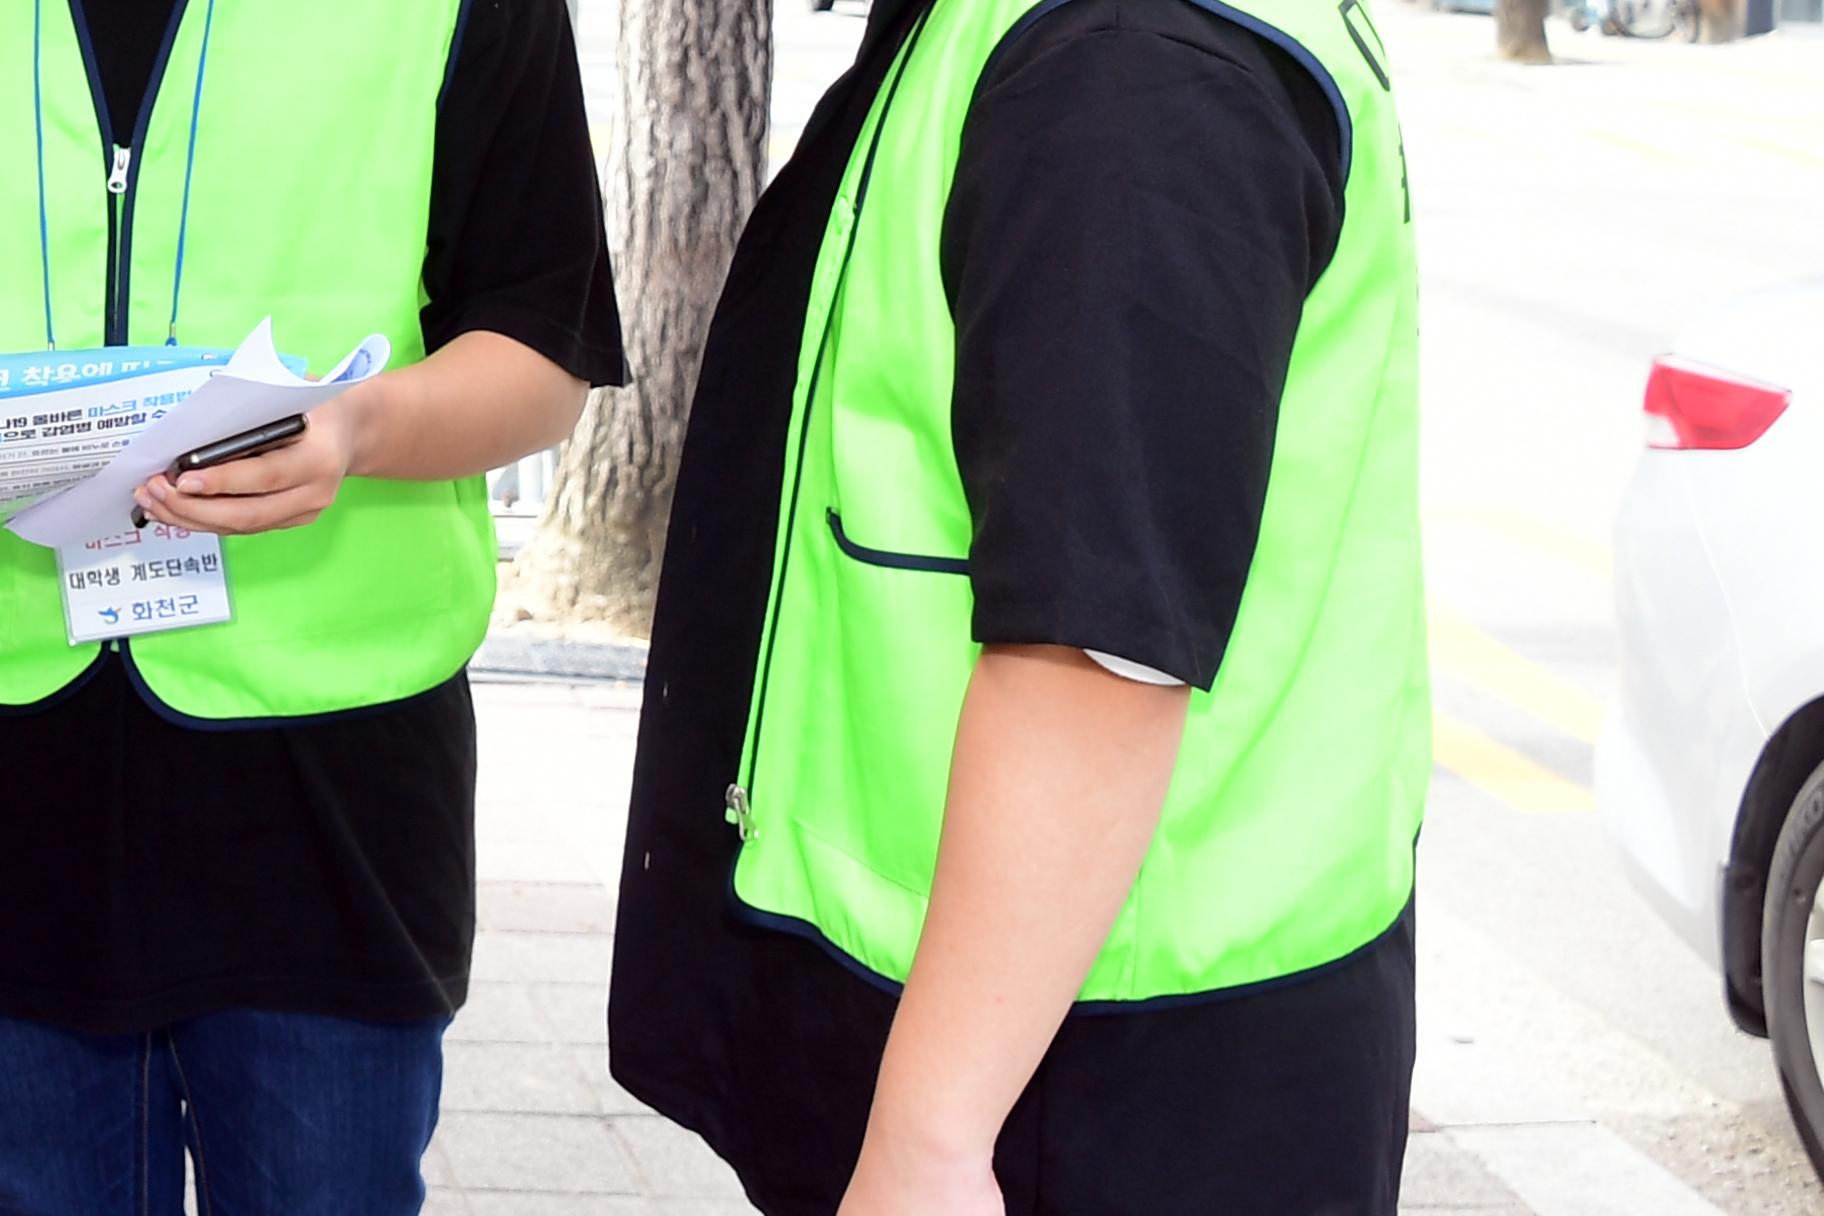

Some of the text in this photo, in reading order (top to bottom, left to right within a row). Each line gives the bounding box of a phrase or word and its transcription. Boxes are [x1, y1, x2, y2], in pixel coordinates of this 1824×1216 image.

[87, 399, 137, 418] 마스크
[69, 553, 218, 590] 대학생 계도단속반
[132, 594, 199, 621] 화천군
